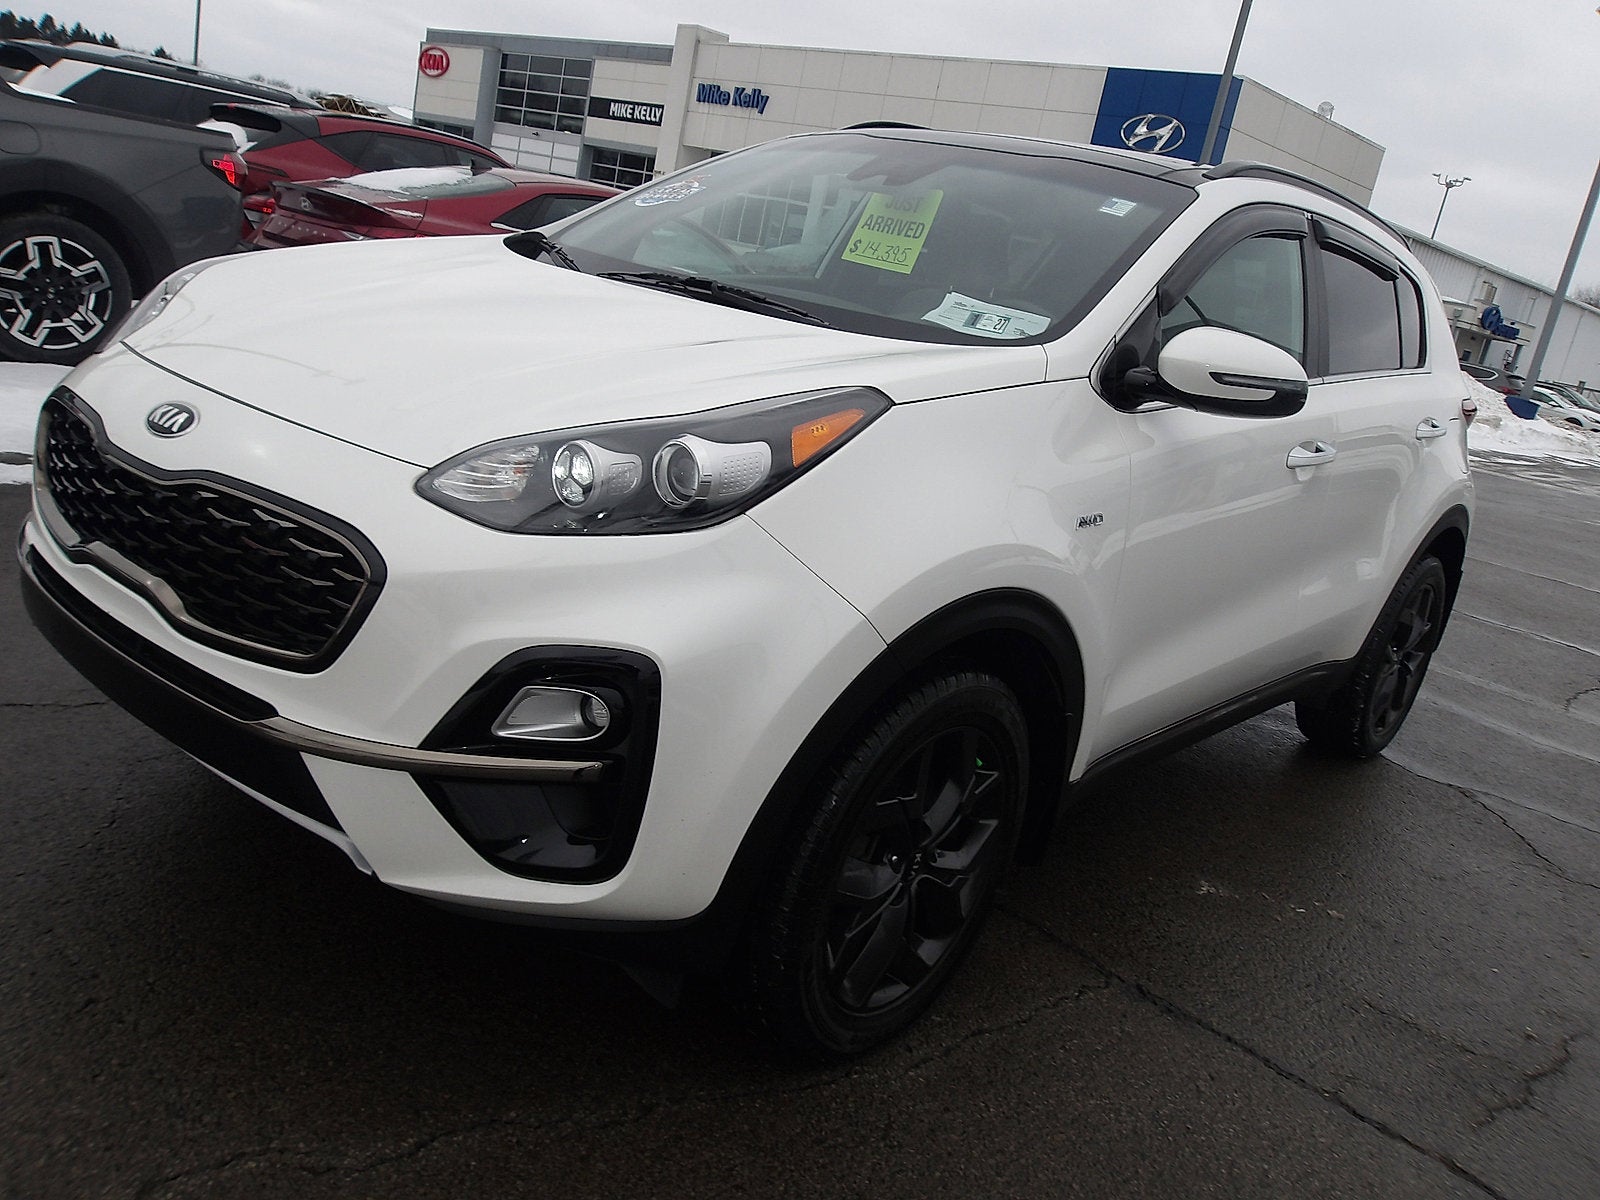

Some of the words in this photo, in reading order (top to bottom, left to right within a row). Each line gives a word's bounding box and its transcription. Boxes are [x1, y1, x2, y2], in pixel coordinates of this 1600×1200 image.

[421, 52, 444, 71] KIA
[696, 83, 731, 106] Mike
[732, 86, 769, 114] Kelly
[609, 101, 633, 119] MIKE
[633, 104, 663, 123] KELLY
[861, 214, 926, 240] ARRIVED
[148, 404, 190, 433] KIA
